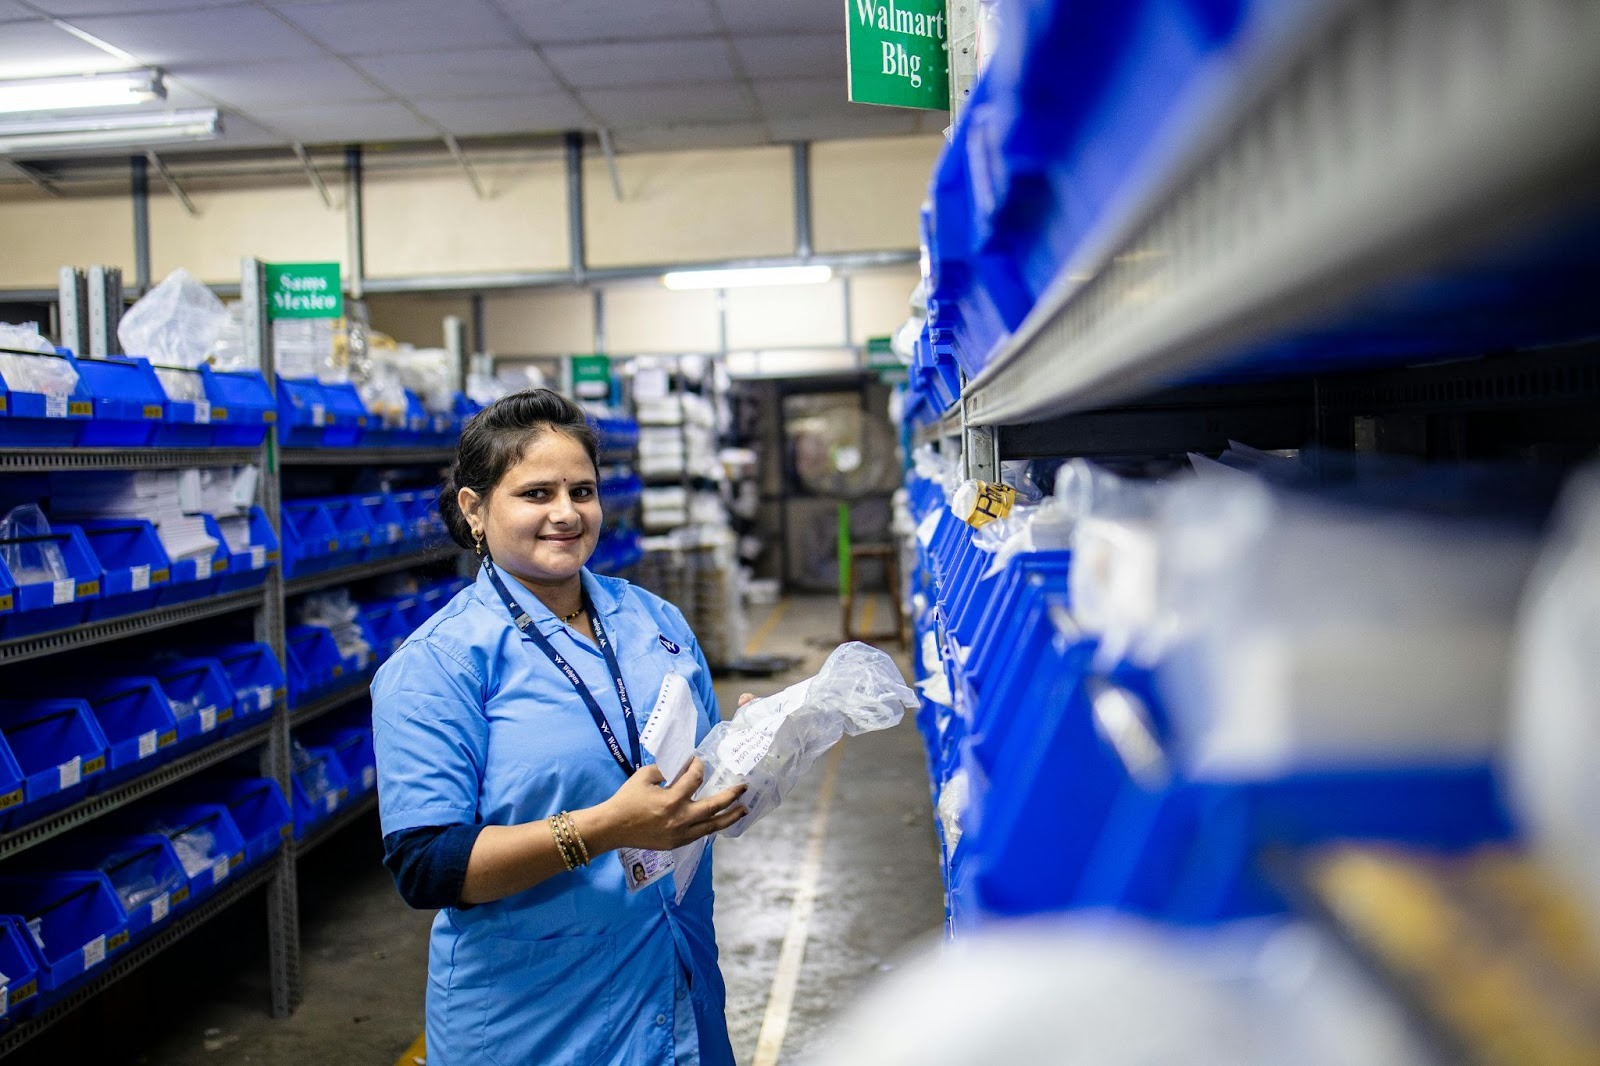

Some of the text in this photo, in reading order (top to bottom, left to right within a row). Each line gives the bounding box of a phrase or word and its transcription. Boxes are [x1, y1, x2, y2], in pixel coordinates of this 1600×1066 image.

[856, 0, 944, 39] Walmart
[881, 41, 922, 88] Bhg
[280, 272, 328, 291] Sams
[273, 291, 337, 310] Mexico
[608, 736, 625, 763] Welspun
